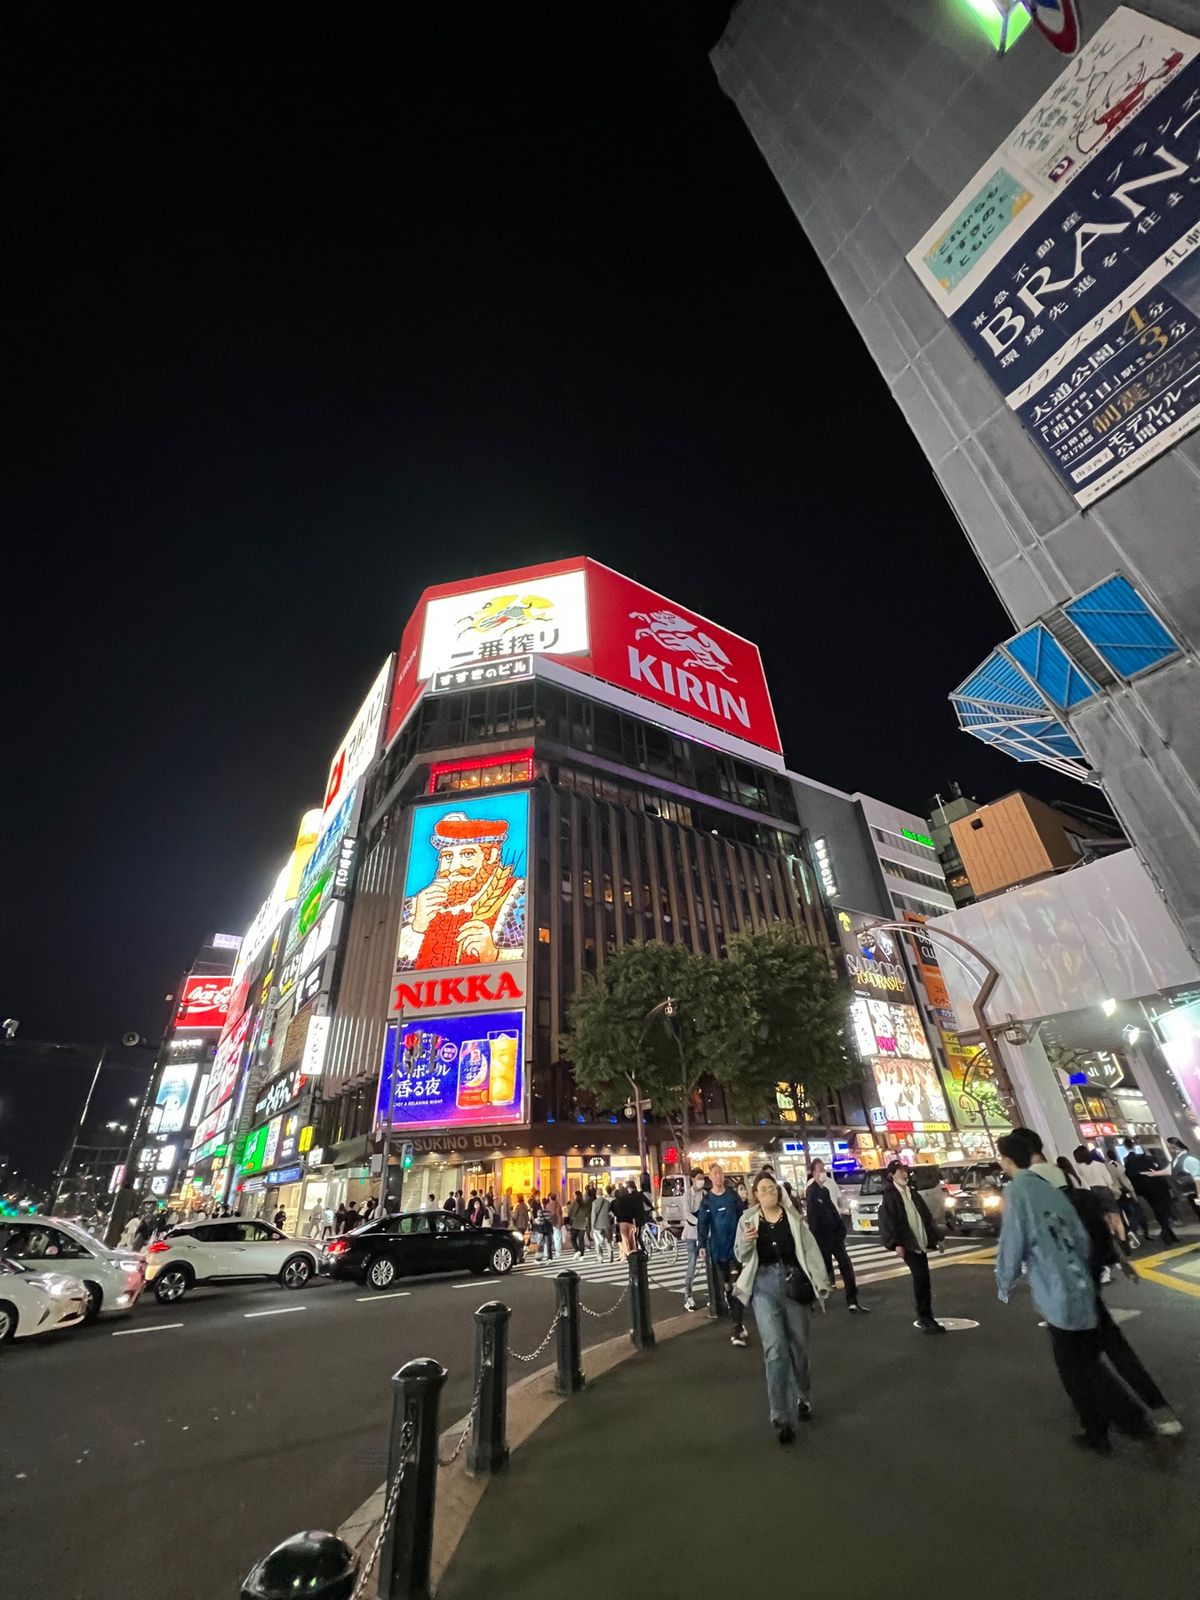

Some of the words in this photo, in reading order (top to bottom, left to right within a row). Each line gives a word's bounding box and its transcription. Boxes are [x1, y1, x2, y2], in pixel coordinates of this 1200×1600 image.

[1028, 342, 1115, 421] 大通公園
[451, 627, 560, 659] 一番搾り
[439, 660, 527, 686] すすきのビル
[628, 645, 751, 729] KIRIN
[845, 954, 907, 985] SAPPORO
[393, 971, 524, 1011] NIKKA
[395, 1078, 441, 1098] 香る夜
[395, 1136, 468, 1153] SSUKINO
[473, 1134, 507, 1147] BLD.
